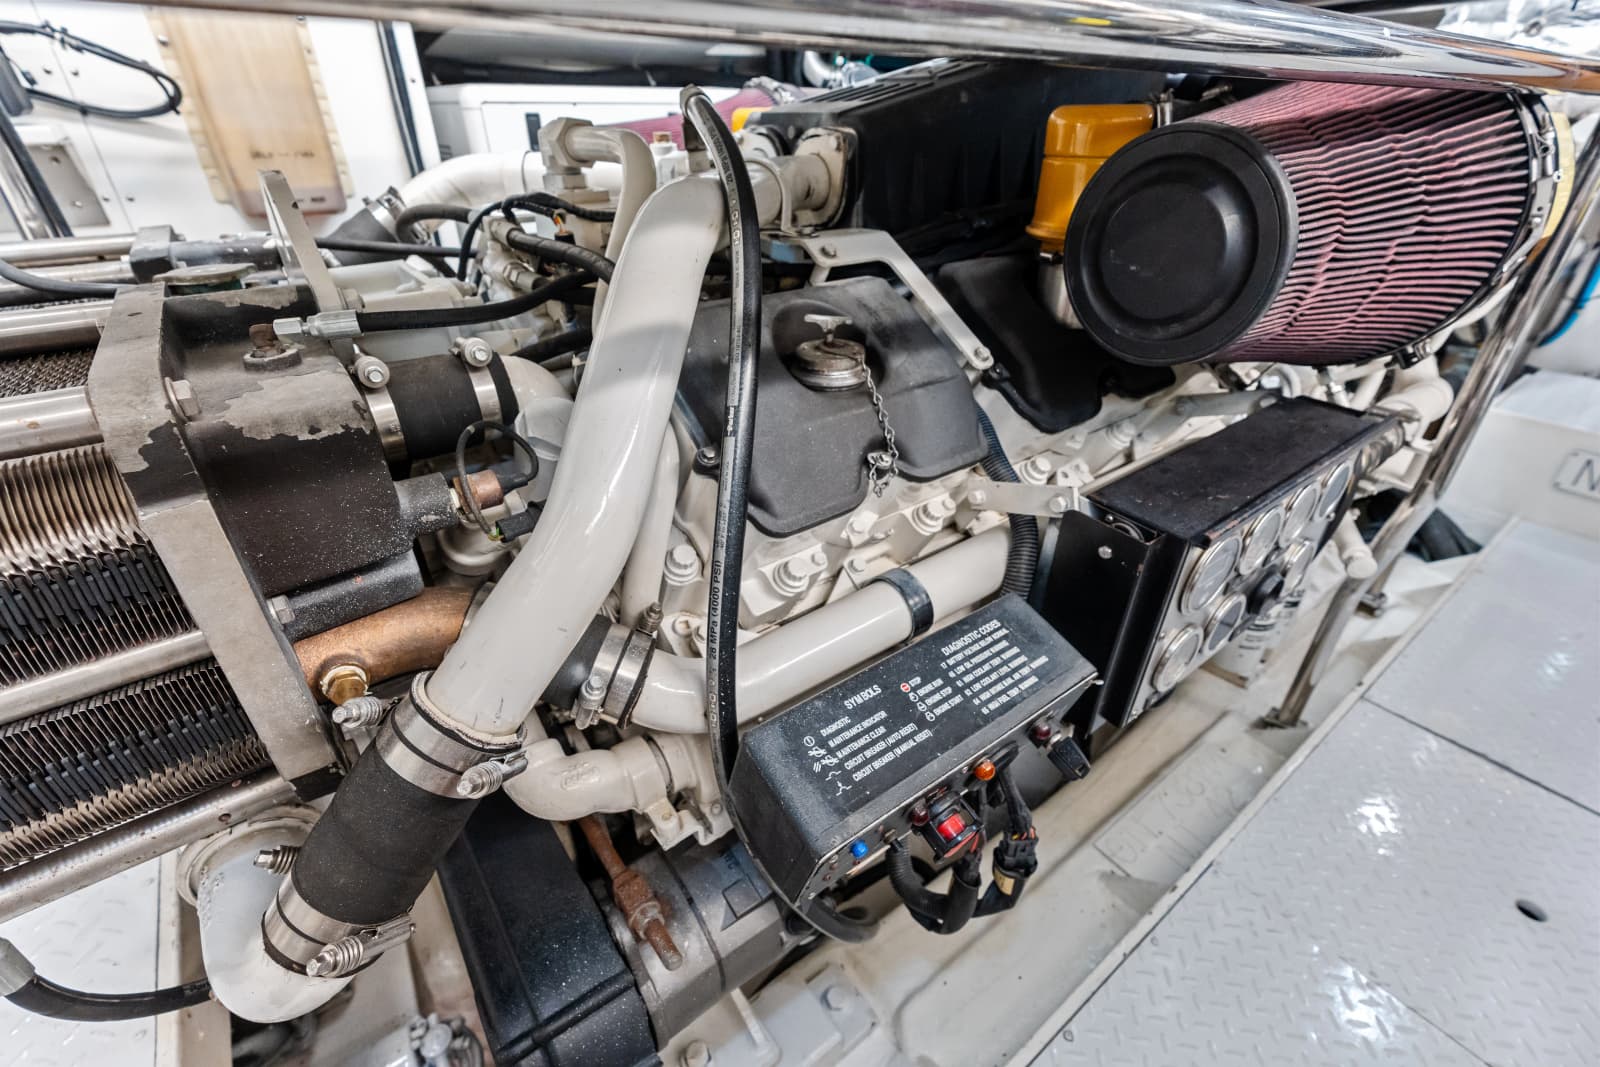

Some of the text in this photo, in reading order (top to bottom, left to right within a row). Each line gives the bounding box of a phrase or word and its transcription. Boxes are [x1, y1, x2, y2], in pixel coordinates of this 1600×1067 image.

[713, 560, 722, 584] PSI)
[711, 587, 720, 617] (4000
[710, 620, 718, 644] MPa
[941, 619, 1001, 656] DIAGNOSTIC CODES
[844, 684, 882, 709] SYMBOLS
[820, 716, 851, 737] DIAGNOSTIC
[869, 726, 886, 739] CLEAR
[844, 753, 866, 770] CIRCUIT
[863, 741, 887, 758] BREAKER
[852, 764, 874, 781] CIRCUIT
[872, 751, 896, 770] BREAKER
